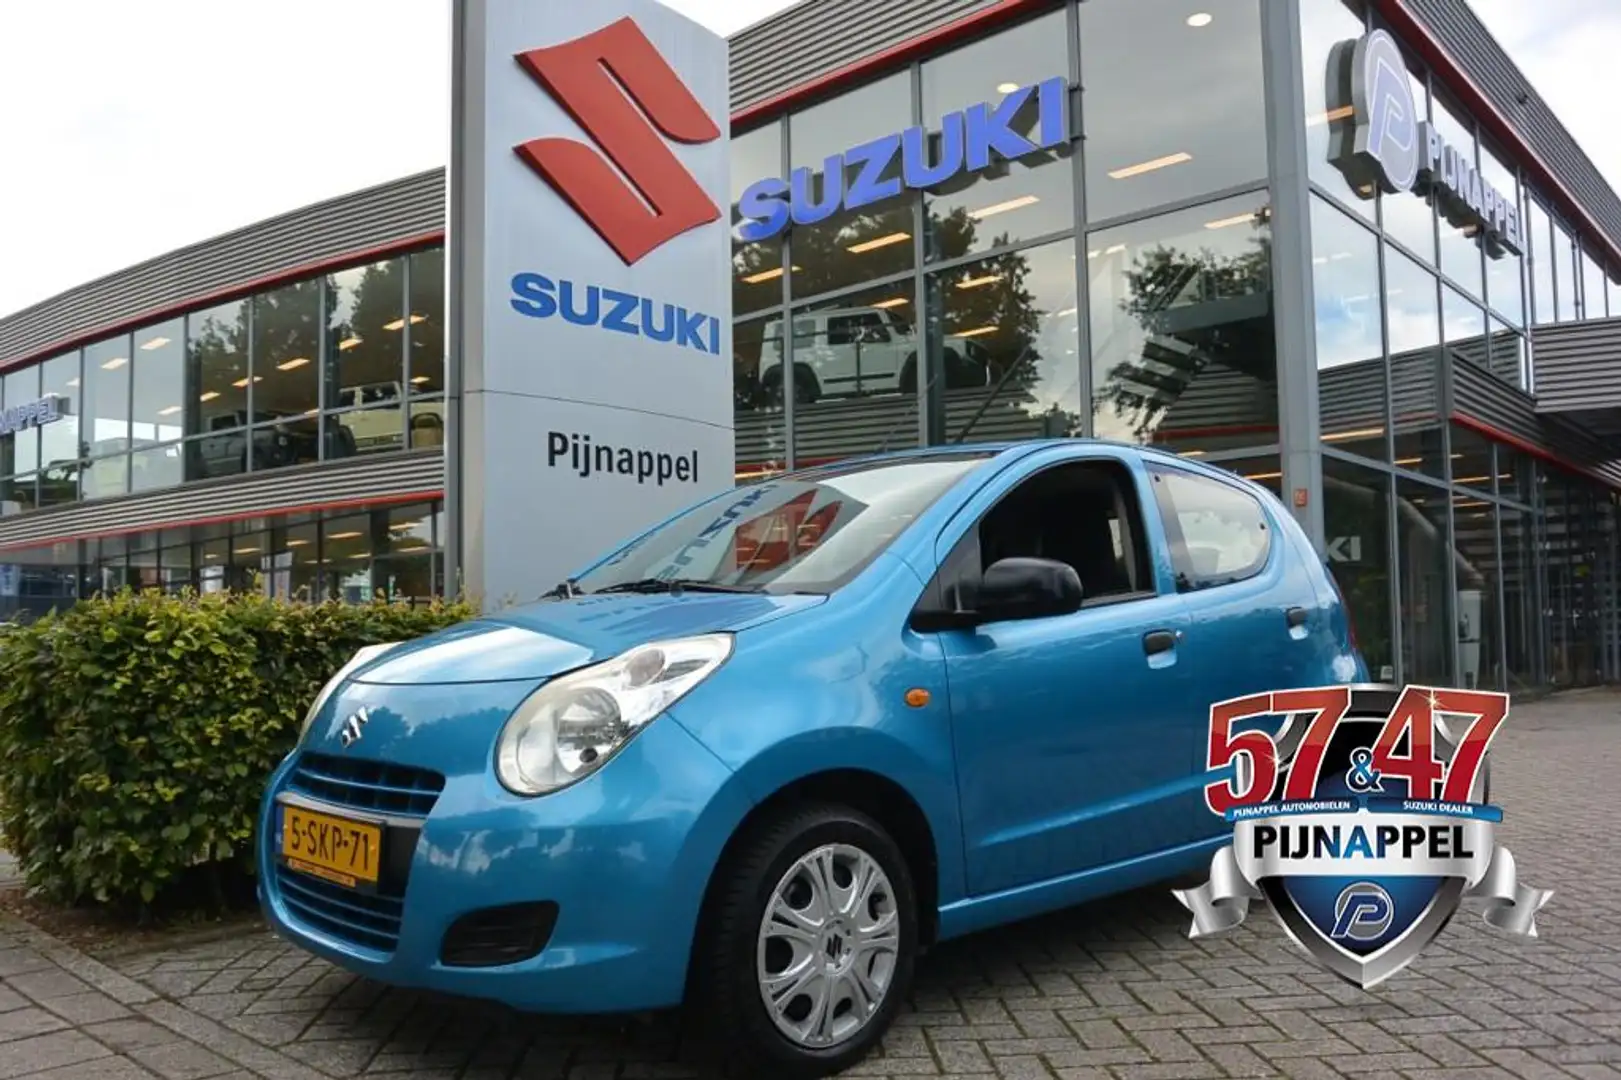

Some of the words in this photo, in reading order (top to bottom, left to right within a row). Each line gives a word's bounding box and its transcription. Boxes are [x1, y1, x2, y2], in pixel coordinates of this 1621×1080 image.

[738, 77, 1070, 242] SUZUKI
[510, 273, 720, 355] SUZUKI
[548, 431, 699, 486] Pijnappel
[291, 815, 369, 872] 5-SKP-71
